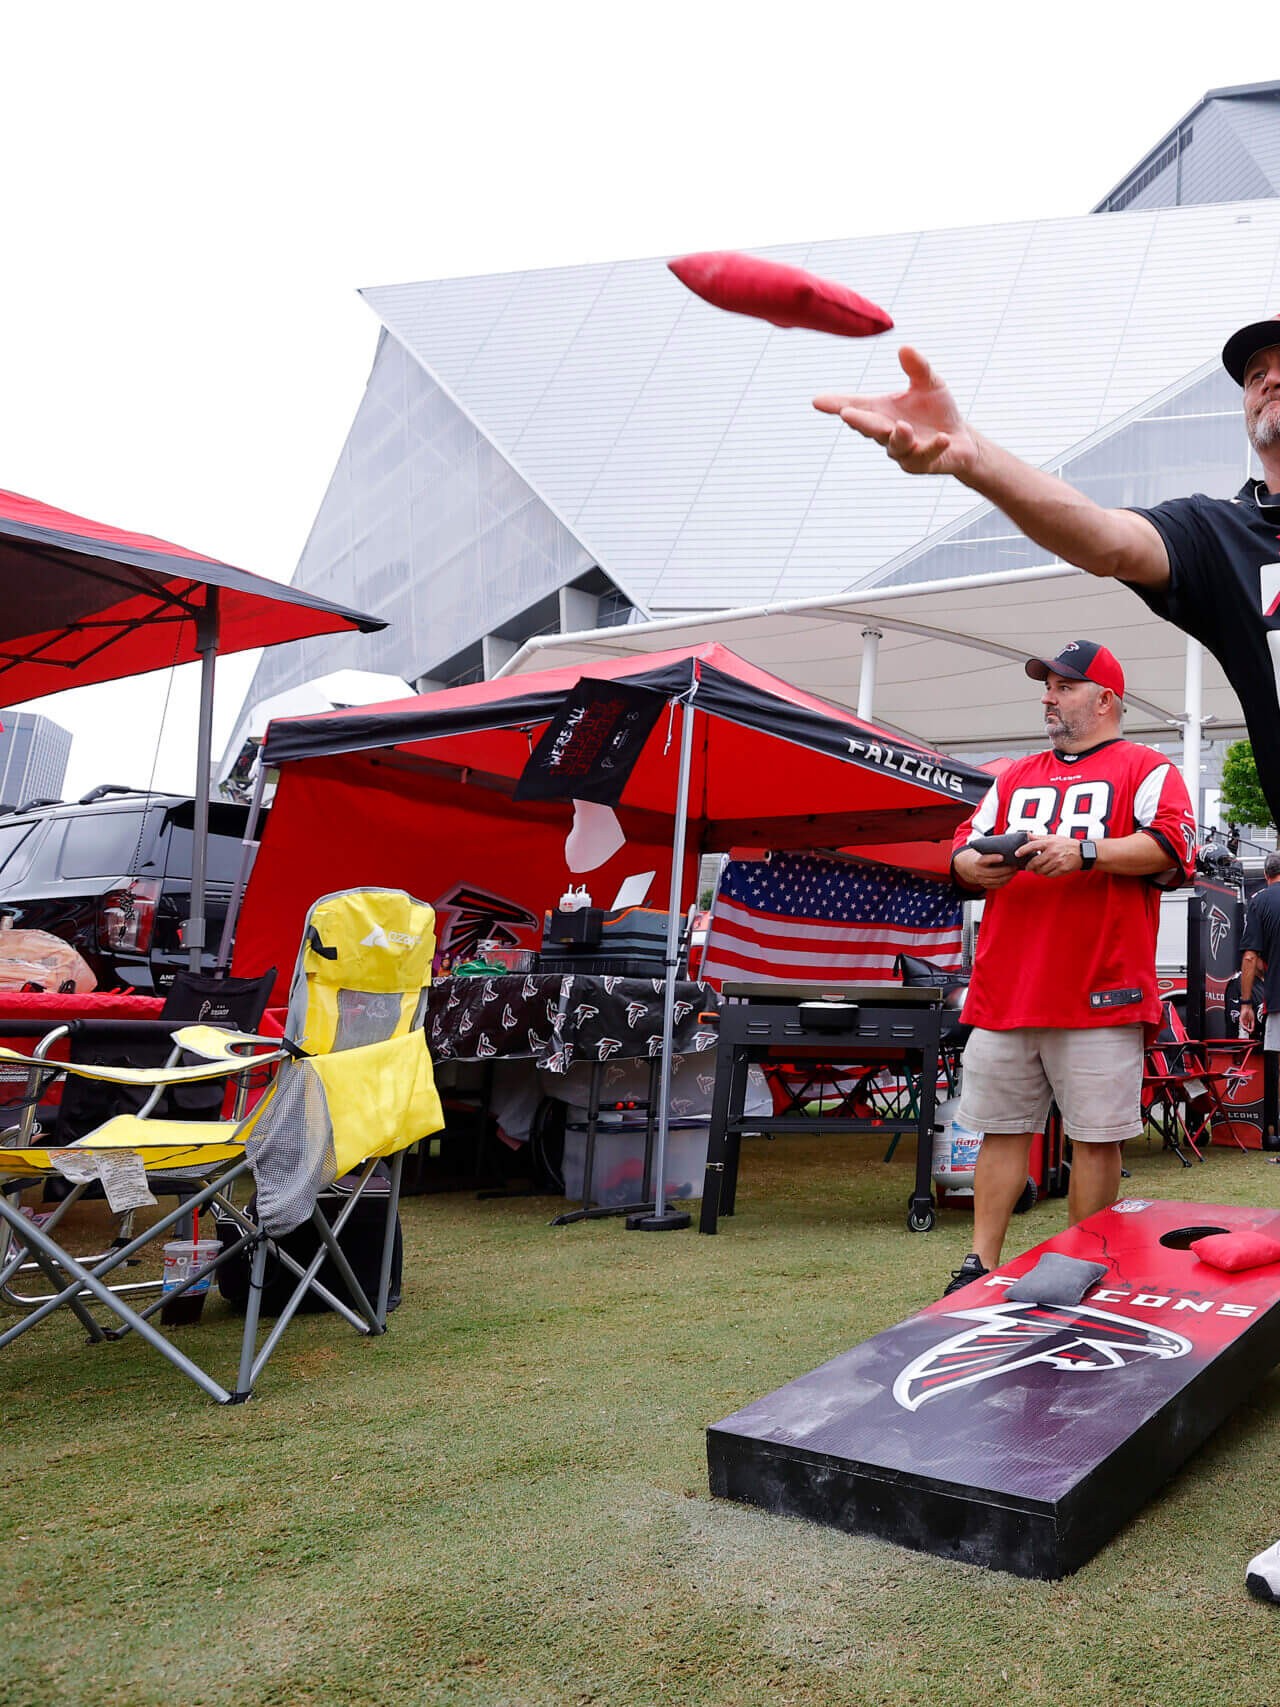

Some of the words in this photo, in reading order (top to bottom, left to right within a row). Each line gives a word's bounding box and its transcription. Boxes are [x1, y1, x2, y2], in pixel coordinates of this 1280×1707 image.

[570, 706, 587, 727] ALL
[843, 737, 964, 794] FALCONS
[1005, 780, 1114, 840] 88
[1215, 1111, 1259, 1119] FLCONS
[984, 1275, 1258, 1318] FCONS
